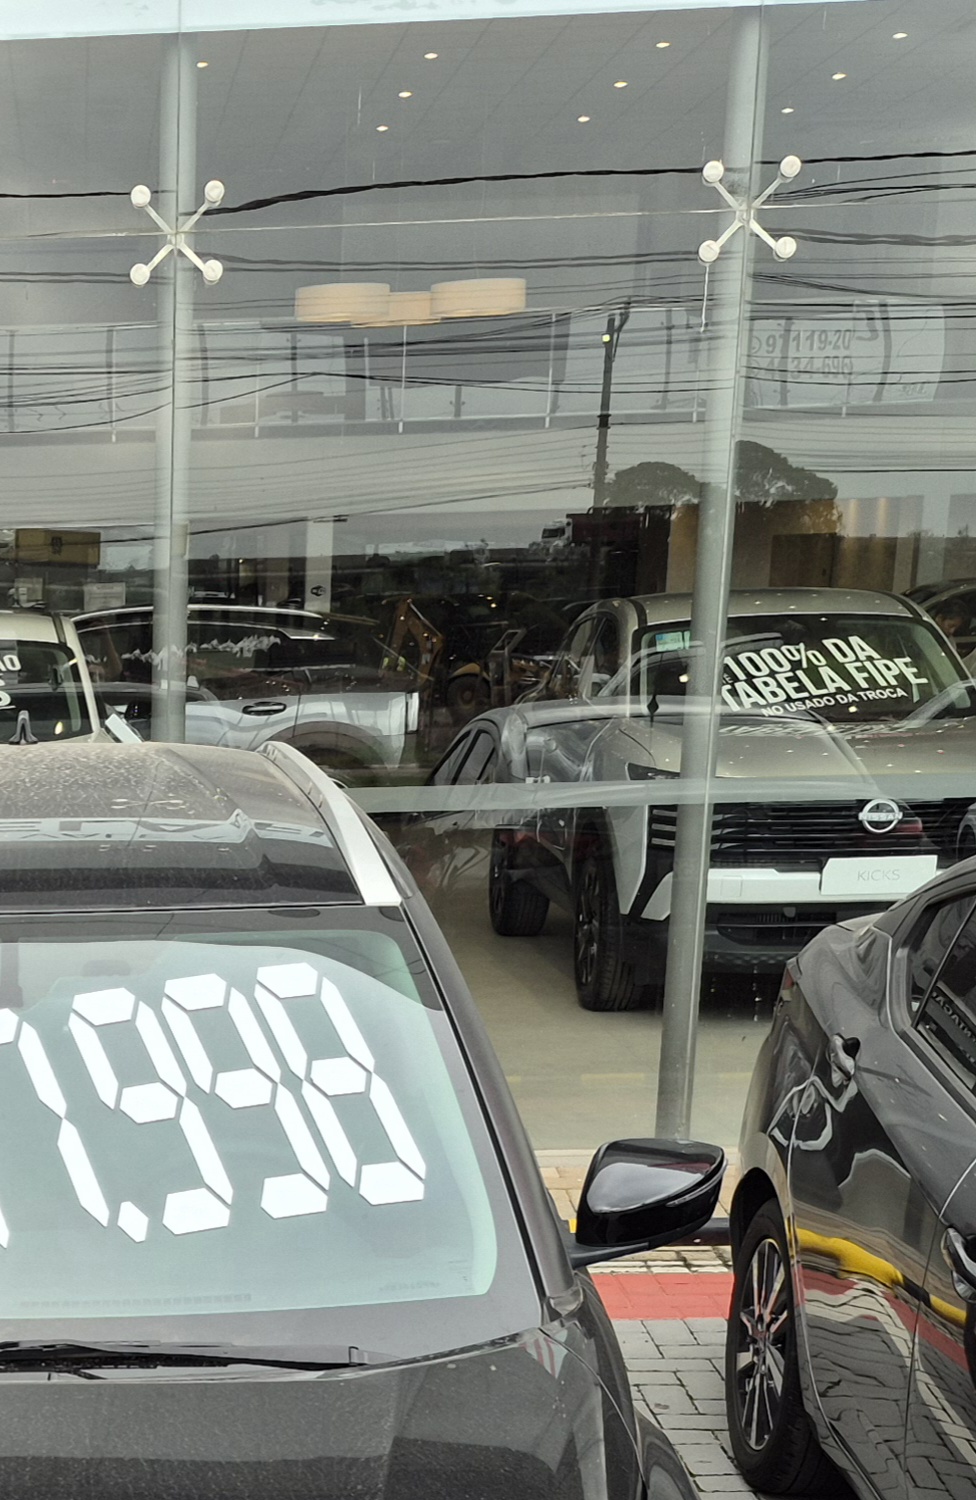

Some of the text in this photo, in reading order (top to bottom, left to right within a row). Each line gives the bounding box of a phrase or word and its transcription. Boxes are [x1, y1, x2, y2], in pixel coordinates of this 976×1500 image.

[723, 635, 882, 681] 100% DA
[721, 656, 929, 712] TABELA FIPE
[760, 686, 909, 717] NO USADO DA TROCA
[857, 868, 901, 881] KICKS
